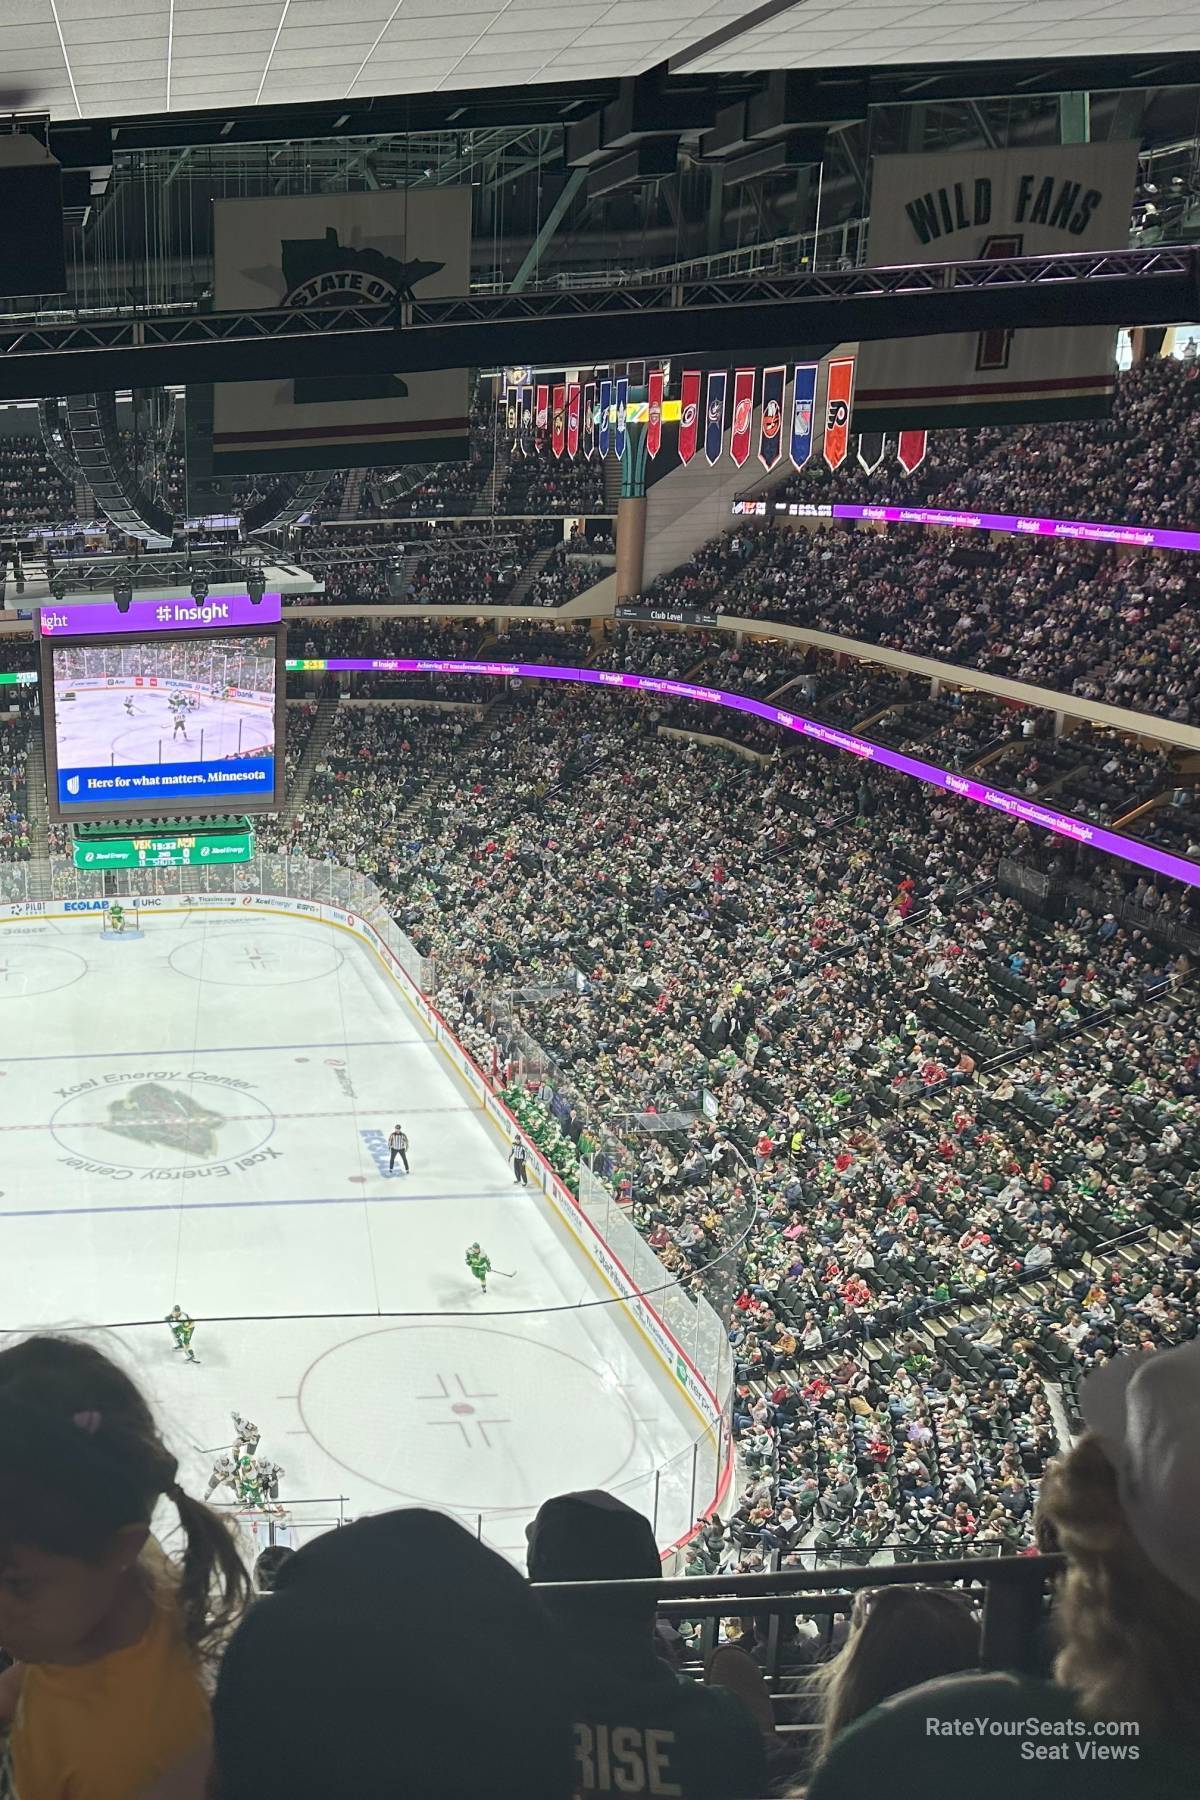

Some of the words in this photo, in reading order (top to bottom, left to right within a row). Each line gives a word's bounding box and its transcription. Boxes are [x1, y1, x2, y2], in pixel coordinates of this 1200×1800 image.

[905, 177, 992, 245] WILD
[1014, 174, 1103, 236] FANS
[290, 272, 362, 306] STATE
[651, 611, 665, 620] Club
[666, 612, 683, 621] Level
[88, 778, 114, 789] Here
[114, 777, 131, 787] for
[132, 775, 160, 786] what
[161, 773, 206, 785] matters,
[207, 770, 265, 782] Minnesota
[25, 902, 46, 911] PILOT
[64, 901, 110, 912] ECOLAB
[141, 899, 161, 907] UHC
[53, 1079, 98, 1099] Xcel
[103, 1071, 182, 1084] Energy
[187, 1071, 259, 1091] Center
[235, 1147, 283, 1167] Xcel
[57, 1156, 134, 1181] Center
[140, 1164, 231, 1181] Energy
